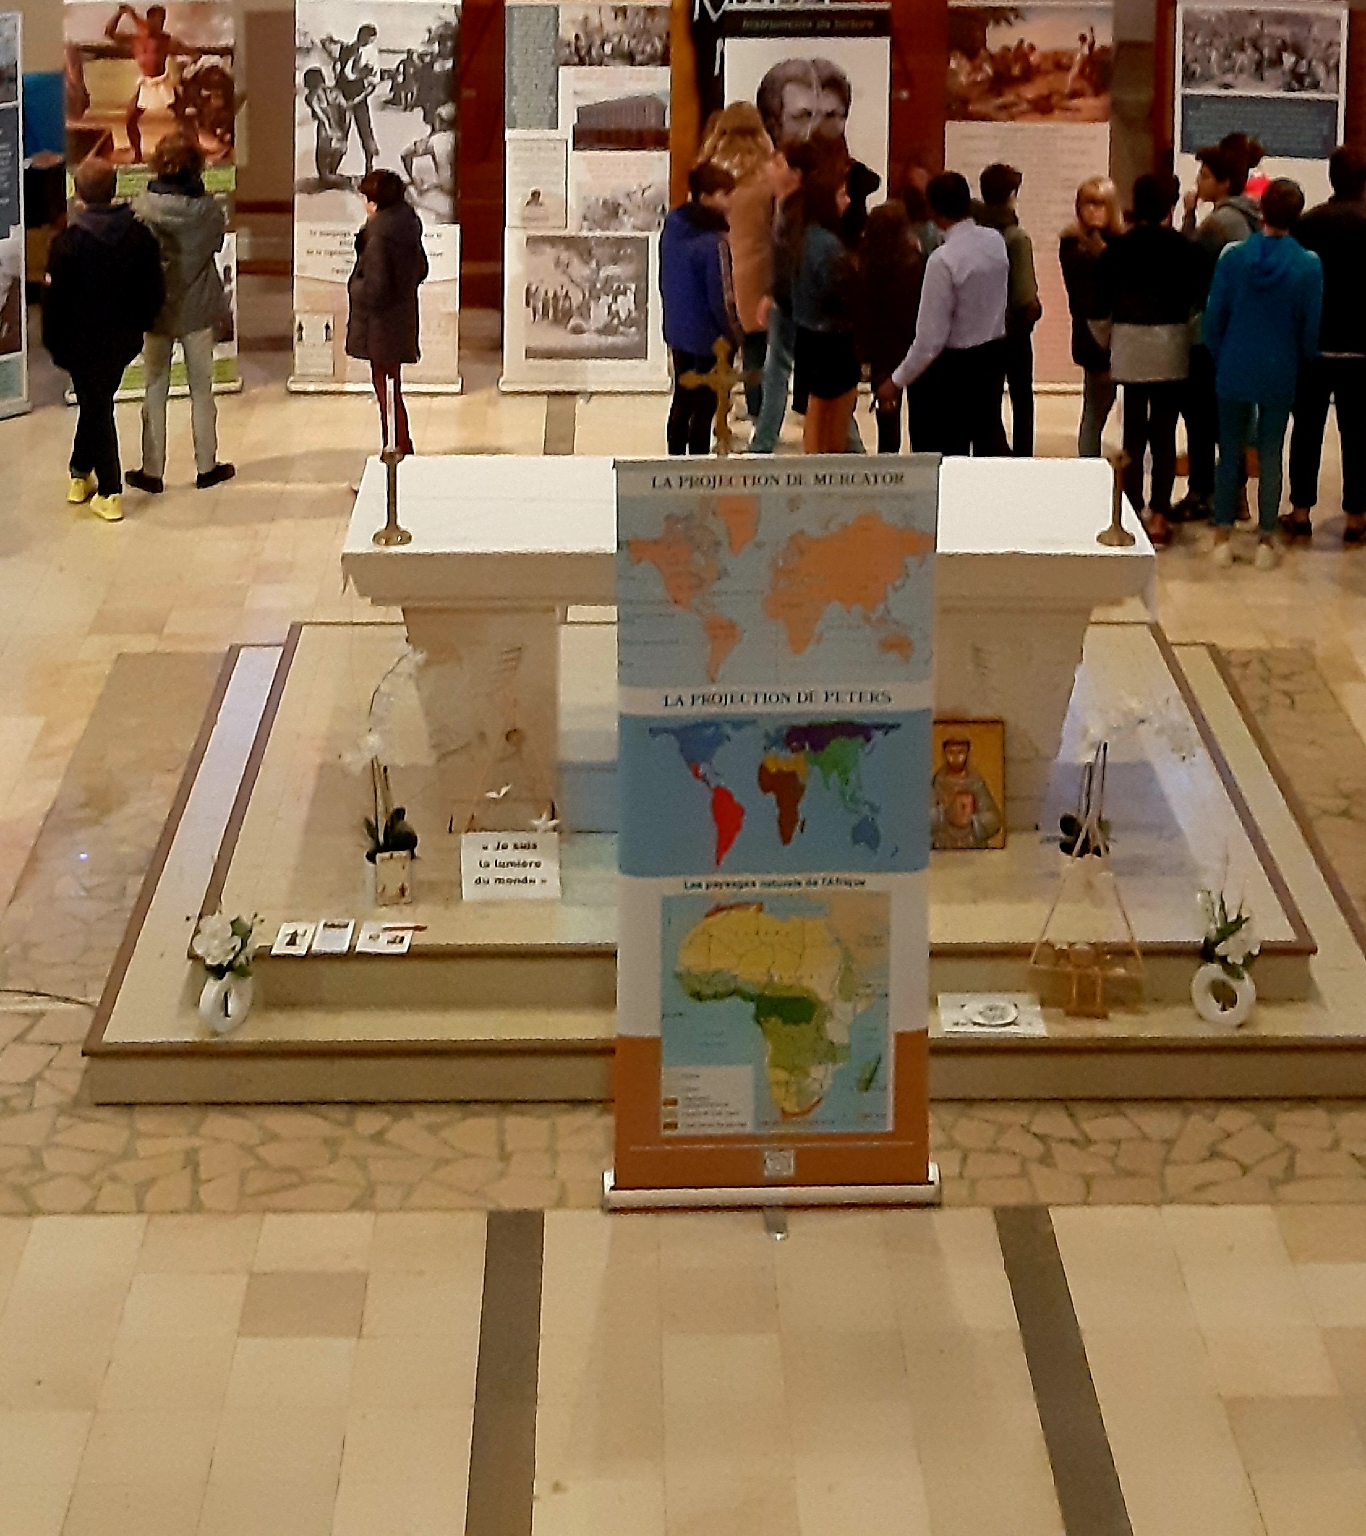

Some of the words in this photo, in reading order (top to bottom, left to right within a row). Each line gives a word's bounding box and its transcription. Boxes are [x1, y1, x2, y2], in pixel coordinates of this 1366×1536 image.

[651, 474, 672, 490] LA
[678, 473, 780, 490] PROJECTION
[786, 473, 807, 487] DE
[813, 472, 905, 487] MERCATOR
[663, 693, 685, 708] LA
[689, 692, 791, 707] PROJECTION
[796, 690, 816, 704] DE
[823, 690, 893, 704] PETERS
[513, 842, 538, 850] suis
[479, 860, 490, 868] la
[495, 859, 541, 868] lumière
